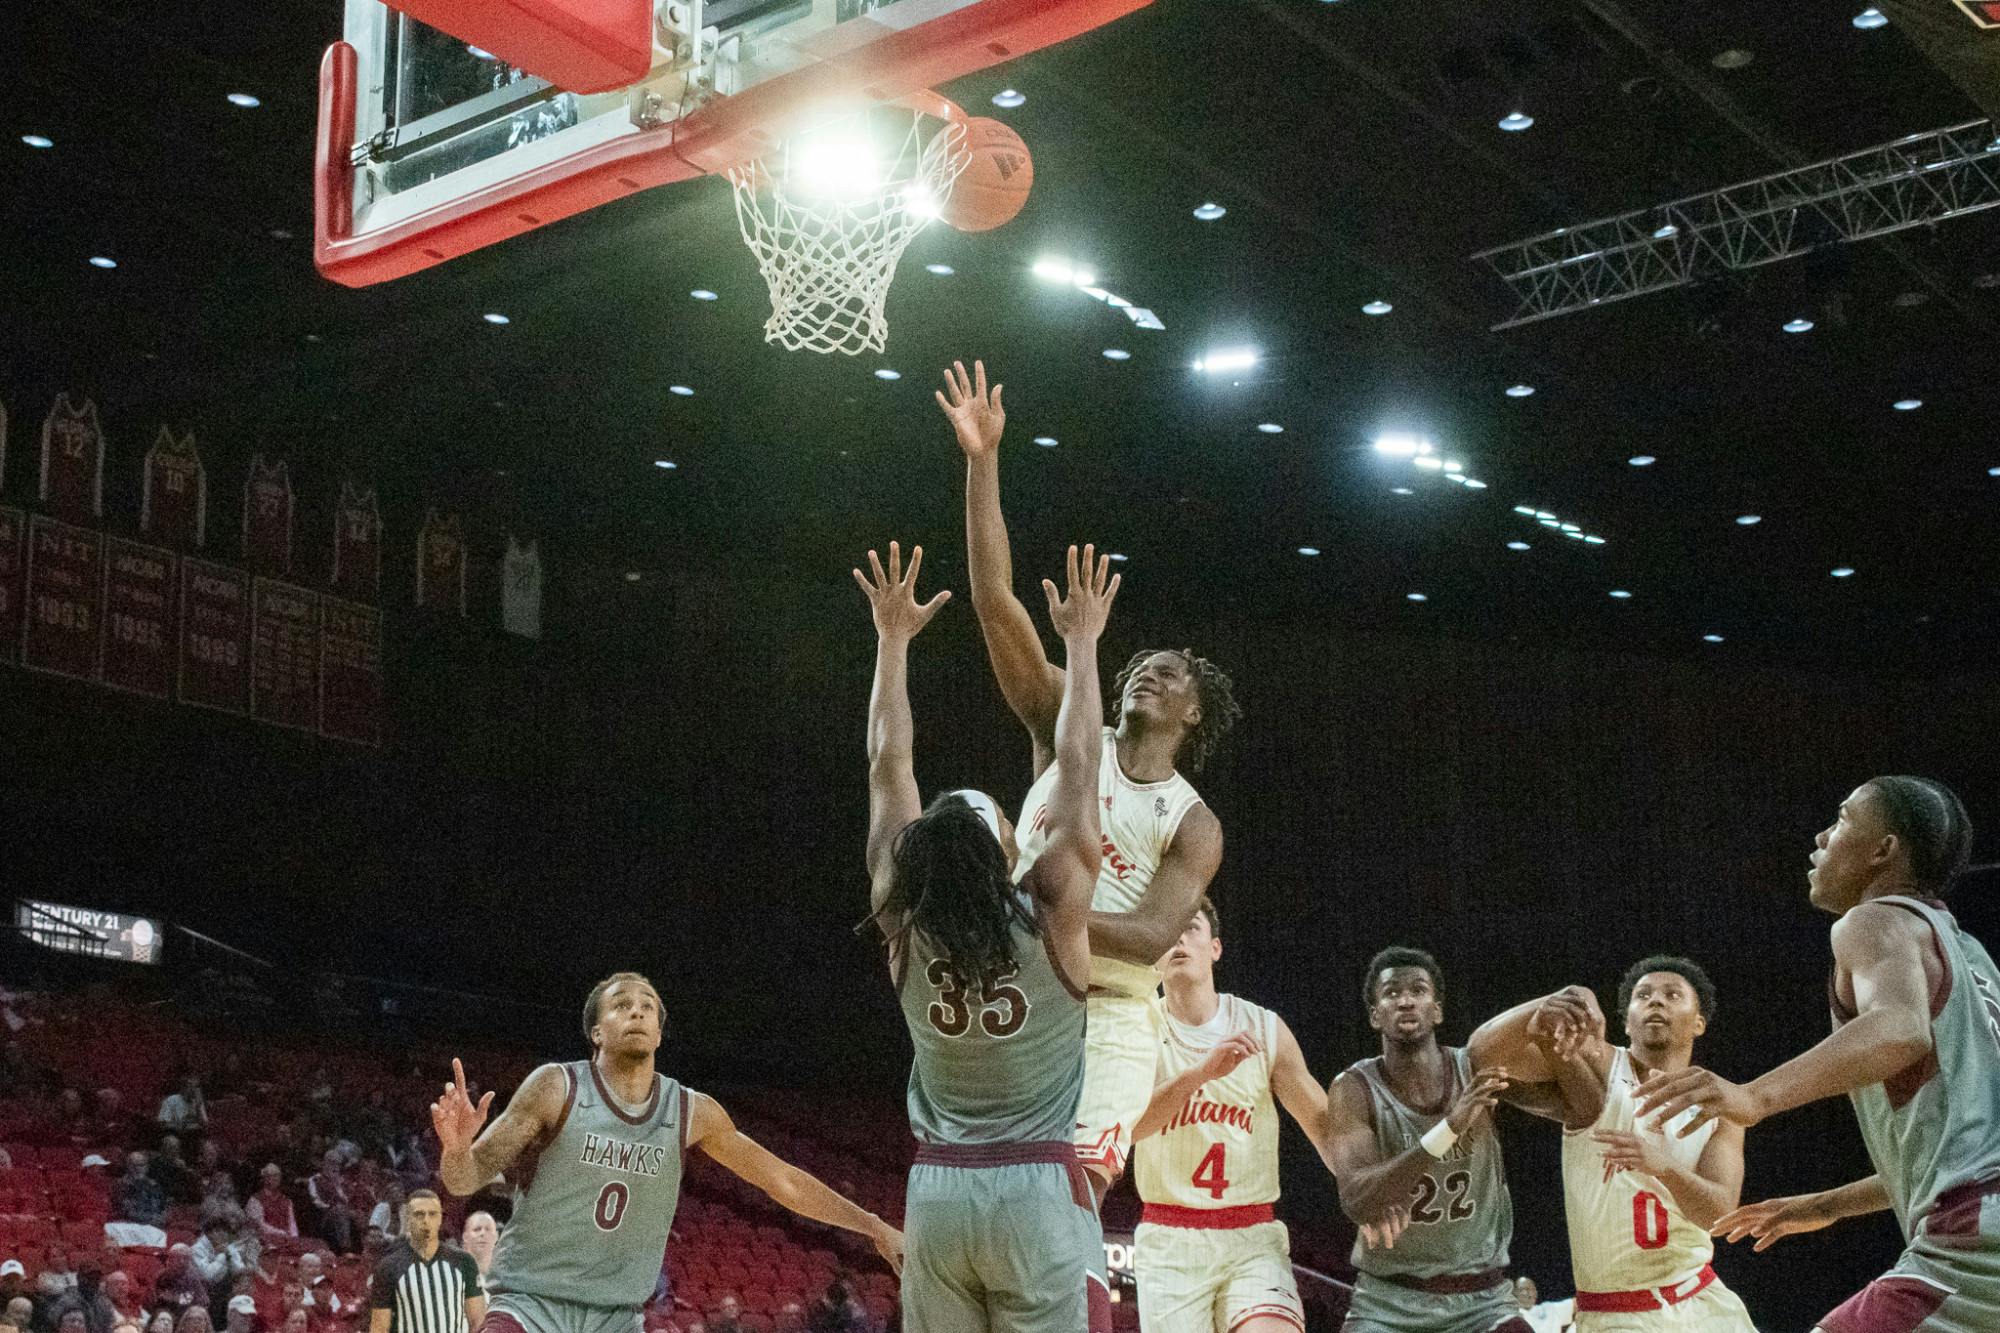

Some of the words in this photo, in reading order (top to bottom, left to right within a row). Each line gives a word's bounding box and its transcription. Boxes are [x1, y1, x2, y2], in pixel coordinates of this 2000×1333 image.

[104, 914, 119, 930] 21
[926, 958, 1031, 1038] 35
[580, 1132, 665, 1177] HAWKS
[1192, 1143, 1229, 1199] 4
[594, 1180, 629, 1232] 0
[1409, 1170, 1476, 1225] 22
[1633, 1190, 1669, 1249] 0
